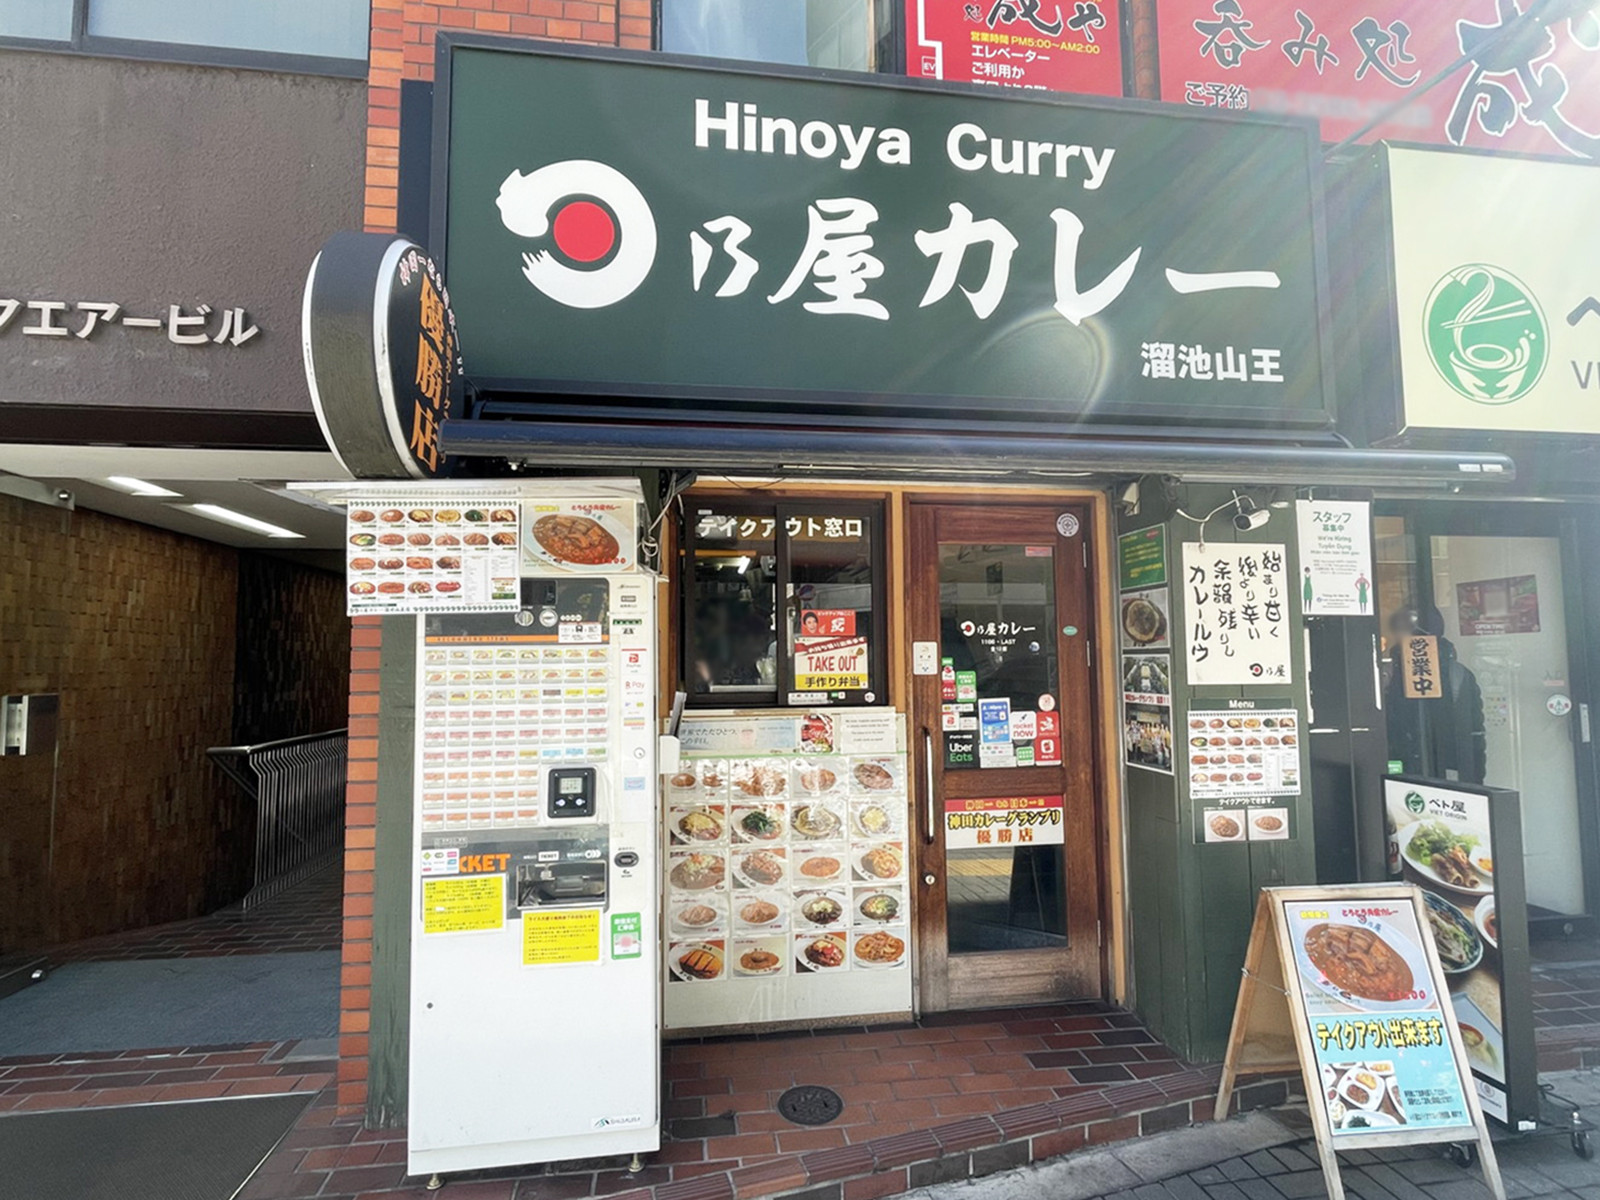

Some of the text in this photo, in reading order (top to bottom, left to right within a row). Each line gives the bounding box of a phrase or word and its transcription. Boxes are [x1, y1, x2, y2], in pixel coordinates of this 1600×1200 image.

[970, 31, 1009, 45] 営業時間
[1194, 0, 1421, 86] 呑み処
[971, 44, 1051, 62] エレベーター
[971, 61, 1026, 79] ご利用か
[1185, 81, 1250, 110] ご予約
[694, 98, 1116, 190] Hinoya Curry
[410, 272, 446, 473] 優勝店
[1140, 341, 1285, 383] 溜池山王
[697, 516, 863, 538] テイクアウト窓口
[1312, 511, 1352, 523] スタッフ
[1238, 556, 1261, 640] 後より辛い
[1262, 550, 1282, 638] 始まり甘く
[1189, 565, 1212, 663] カレールウ
[807, 655, 858, 672] TAKE OUT
[1410, 637, 1433, 696] 営業中
[804, 675, 860, 687] 手作り弁当
[1228, 699, 1255, 709] Menu
[1013, 730, 1034, 738] now
[949, 743, 973, 752] Uber
[949, 753, 974, 762] Eats
[1429, 799, 1467, 814] ベト屋
[947, 808, 1061, 830] 神田カレーグランプリ
[976, 827, 1033, 844] 優勝店
[458, 853, 511, 874] CKET
[1315, 1018, 1444, 1051] テイクアウト出来ます
